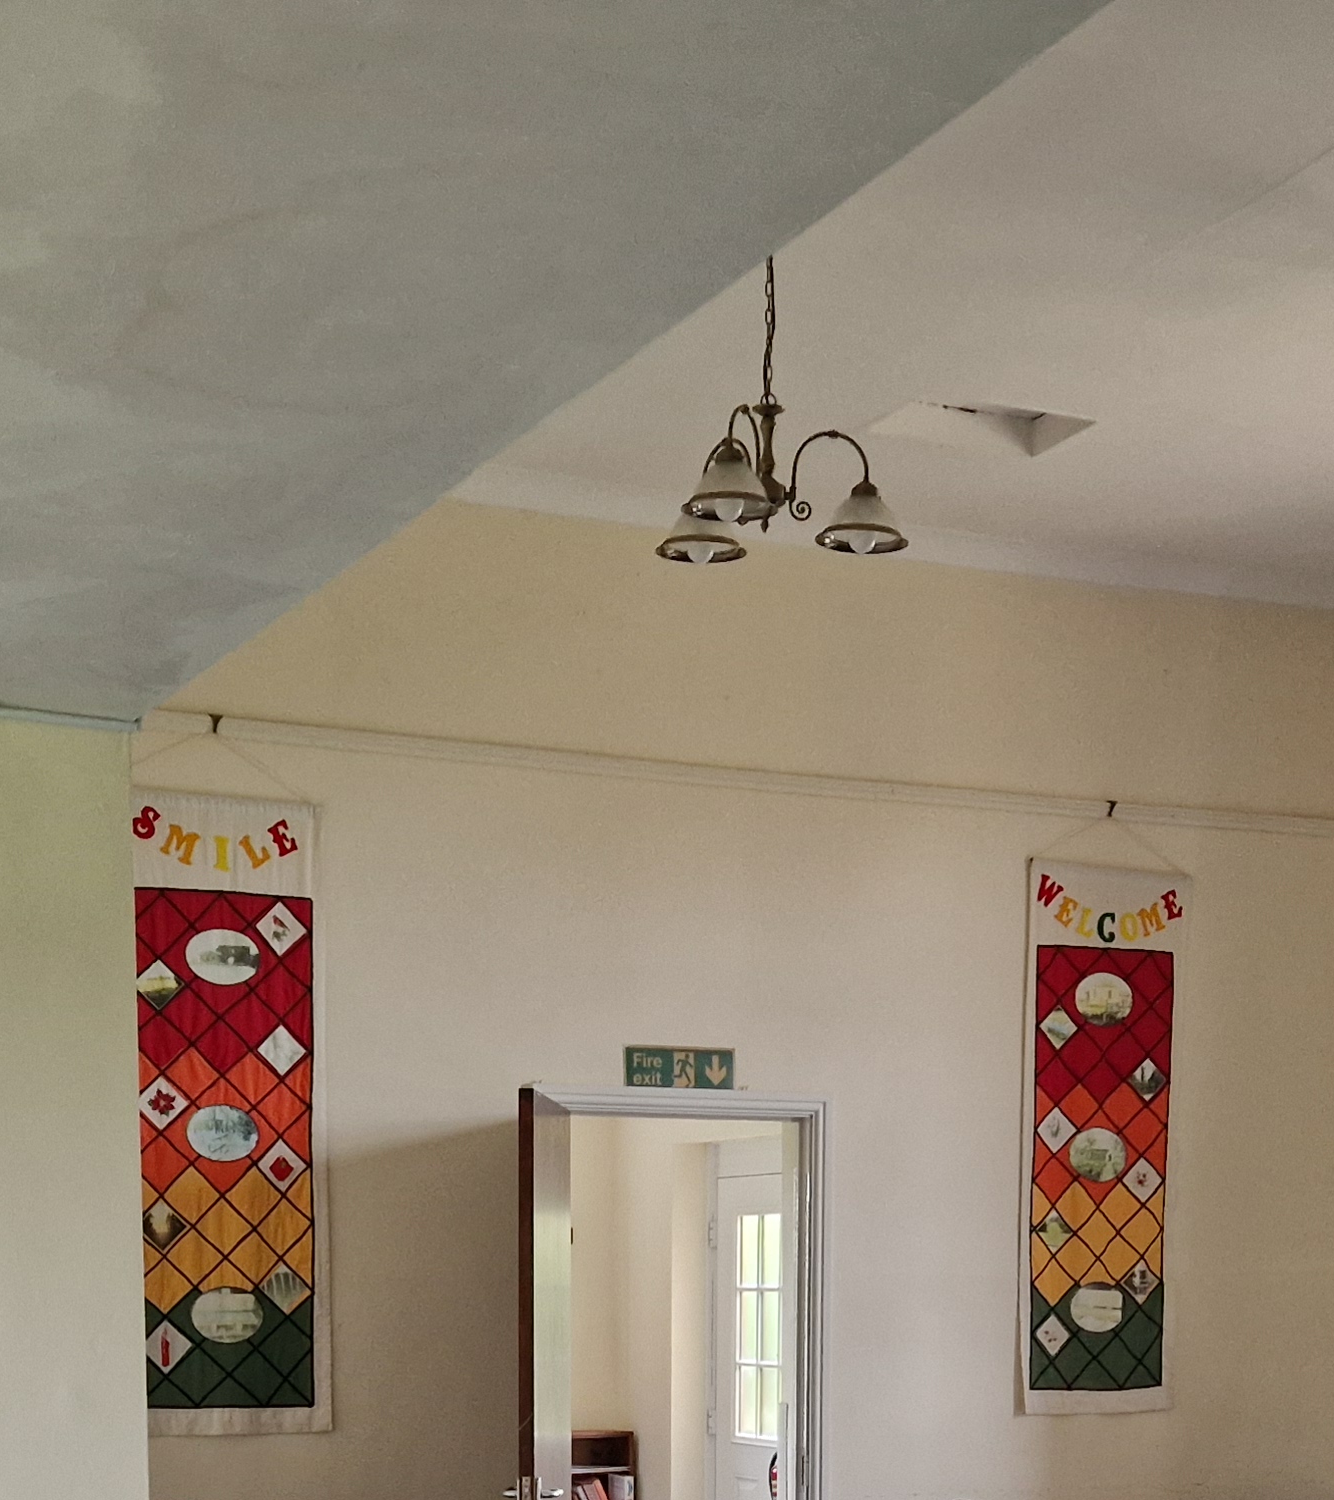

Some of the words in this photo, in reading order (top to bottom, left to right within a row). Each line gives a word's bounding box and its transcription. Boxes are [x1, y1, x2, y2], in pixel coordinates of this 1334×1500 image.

[132, 805, 299, 873] SMILE
[1036, 873, 1184, 943] WELCOME
[632, 1052, 663, 1068] Fire
[632, 1071, 663, 1085] exit
